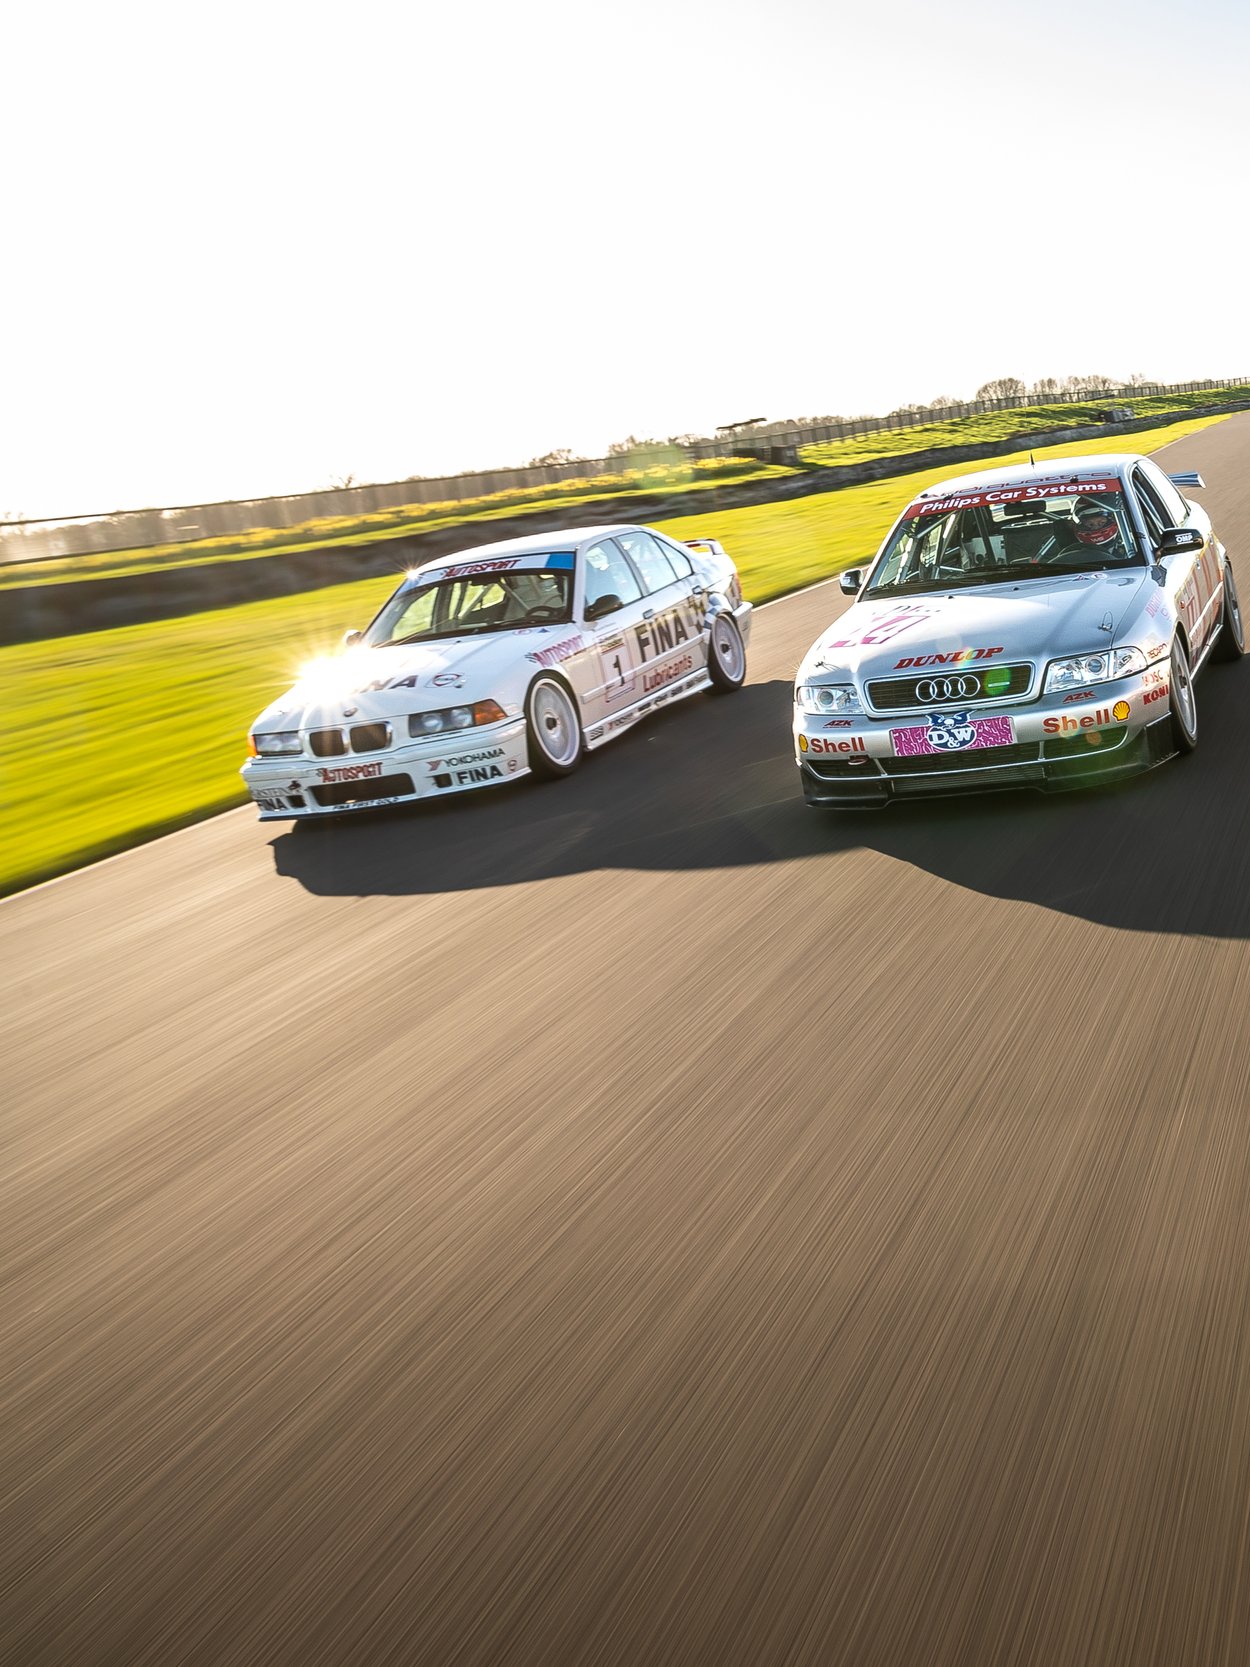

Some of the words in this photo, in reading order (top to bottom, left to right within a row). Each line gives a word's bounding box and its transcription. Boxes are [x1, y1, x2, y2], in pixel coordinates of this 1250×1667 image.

[919, 496, 980, 514] Philips
[986, 489, 1021, 502] Car
[1026, 482, 1107, 498] Systems
[1175, 534, 1193, 543] OMP
[444, 559, 522, 578] AUTOSPORT
[634, 608, 689, 663] FINA
[893, 647, 1004, 670] DUNLOP
[612, 654, 626, 687] 1
[643, 655, 693, 693] Lubricants
[1063, 690, 1097, 703] AZK
[1142, 684, 1169, 705] KONI
[823, 719, 855, 728] AZK
[1043, 708, 1110, 734] Shell
[812, 737, 865, 753] Shell
[929, 726, 975, 748] D&W
[443, 748, 506, 767] YOKOHAMA
[322, 762, 383, 783] AUTOSPORT
[456, 765, 504, 785] FINA
